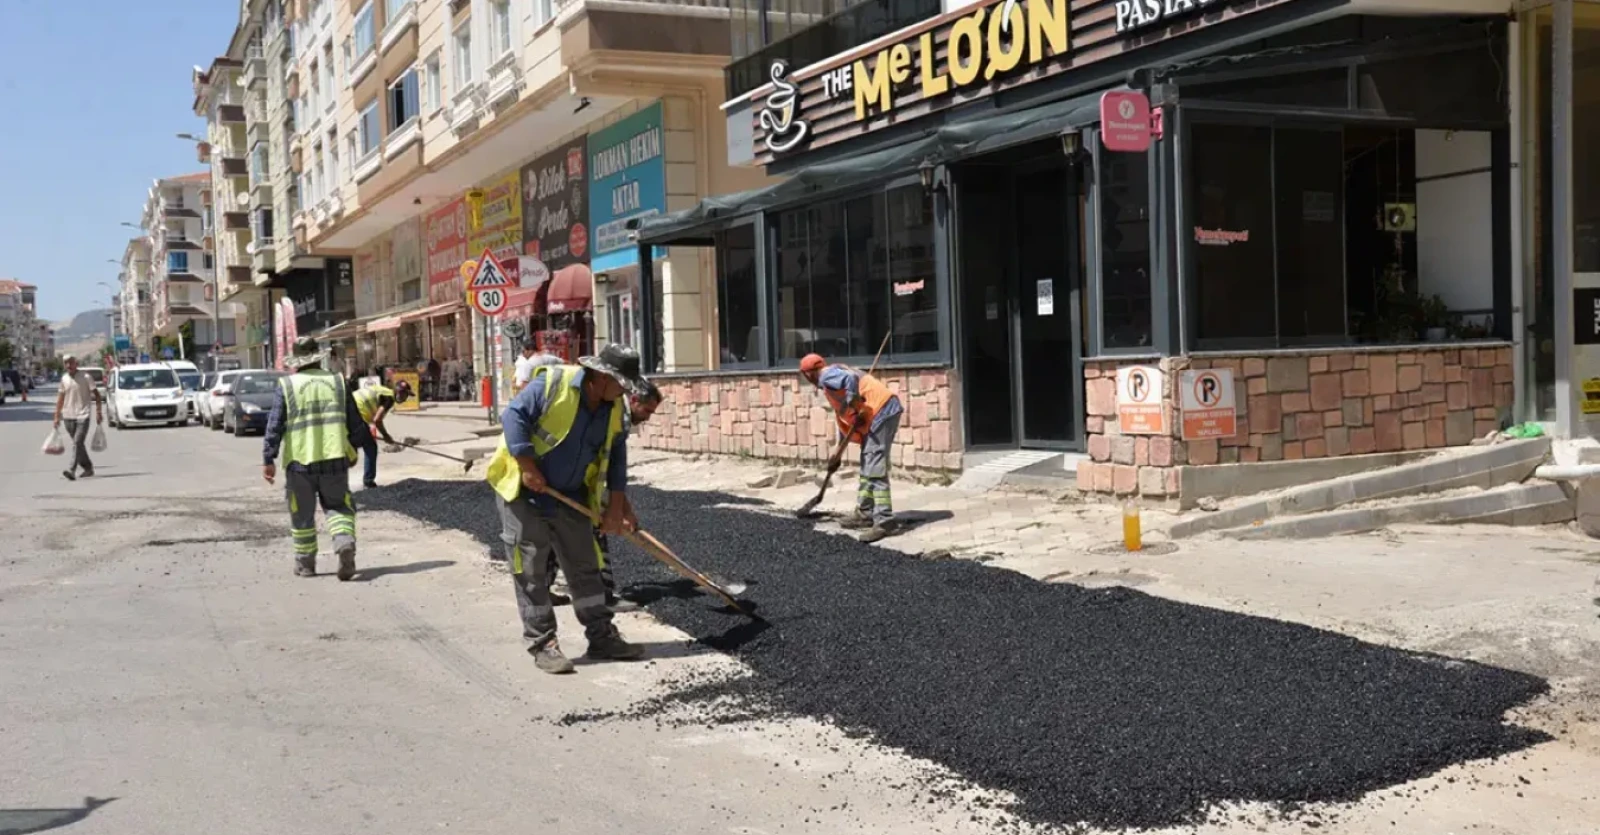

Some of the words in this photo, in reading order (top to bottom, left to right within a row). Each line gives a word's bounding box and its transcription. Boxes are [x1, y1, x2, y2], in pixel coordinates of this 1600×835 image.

[821, 65, 853, 97] THE
[593, 140, 628, 181] LOKMAN
[538, 160, 566, 201] Dilek
[612, 182, 640, 216] AKTAR
[538, 201, 569, 240] Perde
[483, 291, 500, 307] 30
